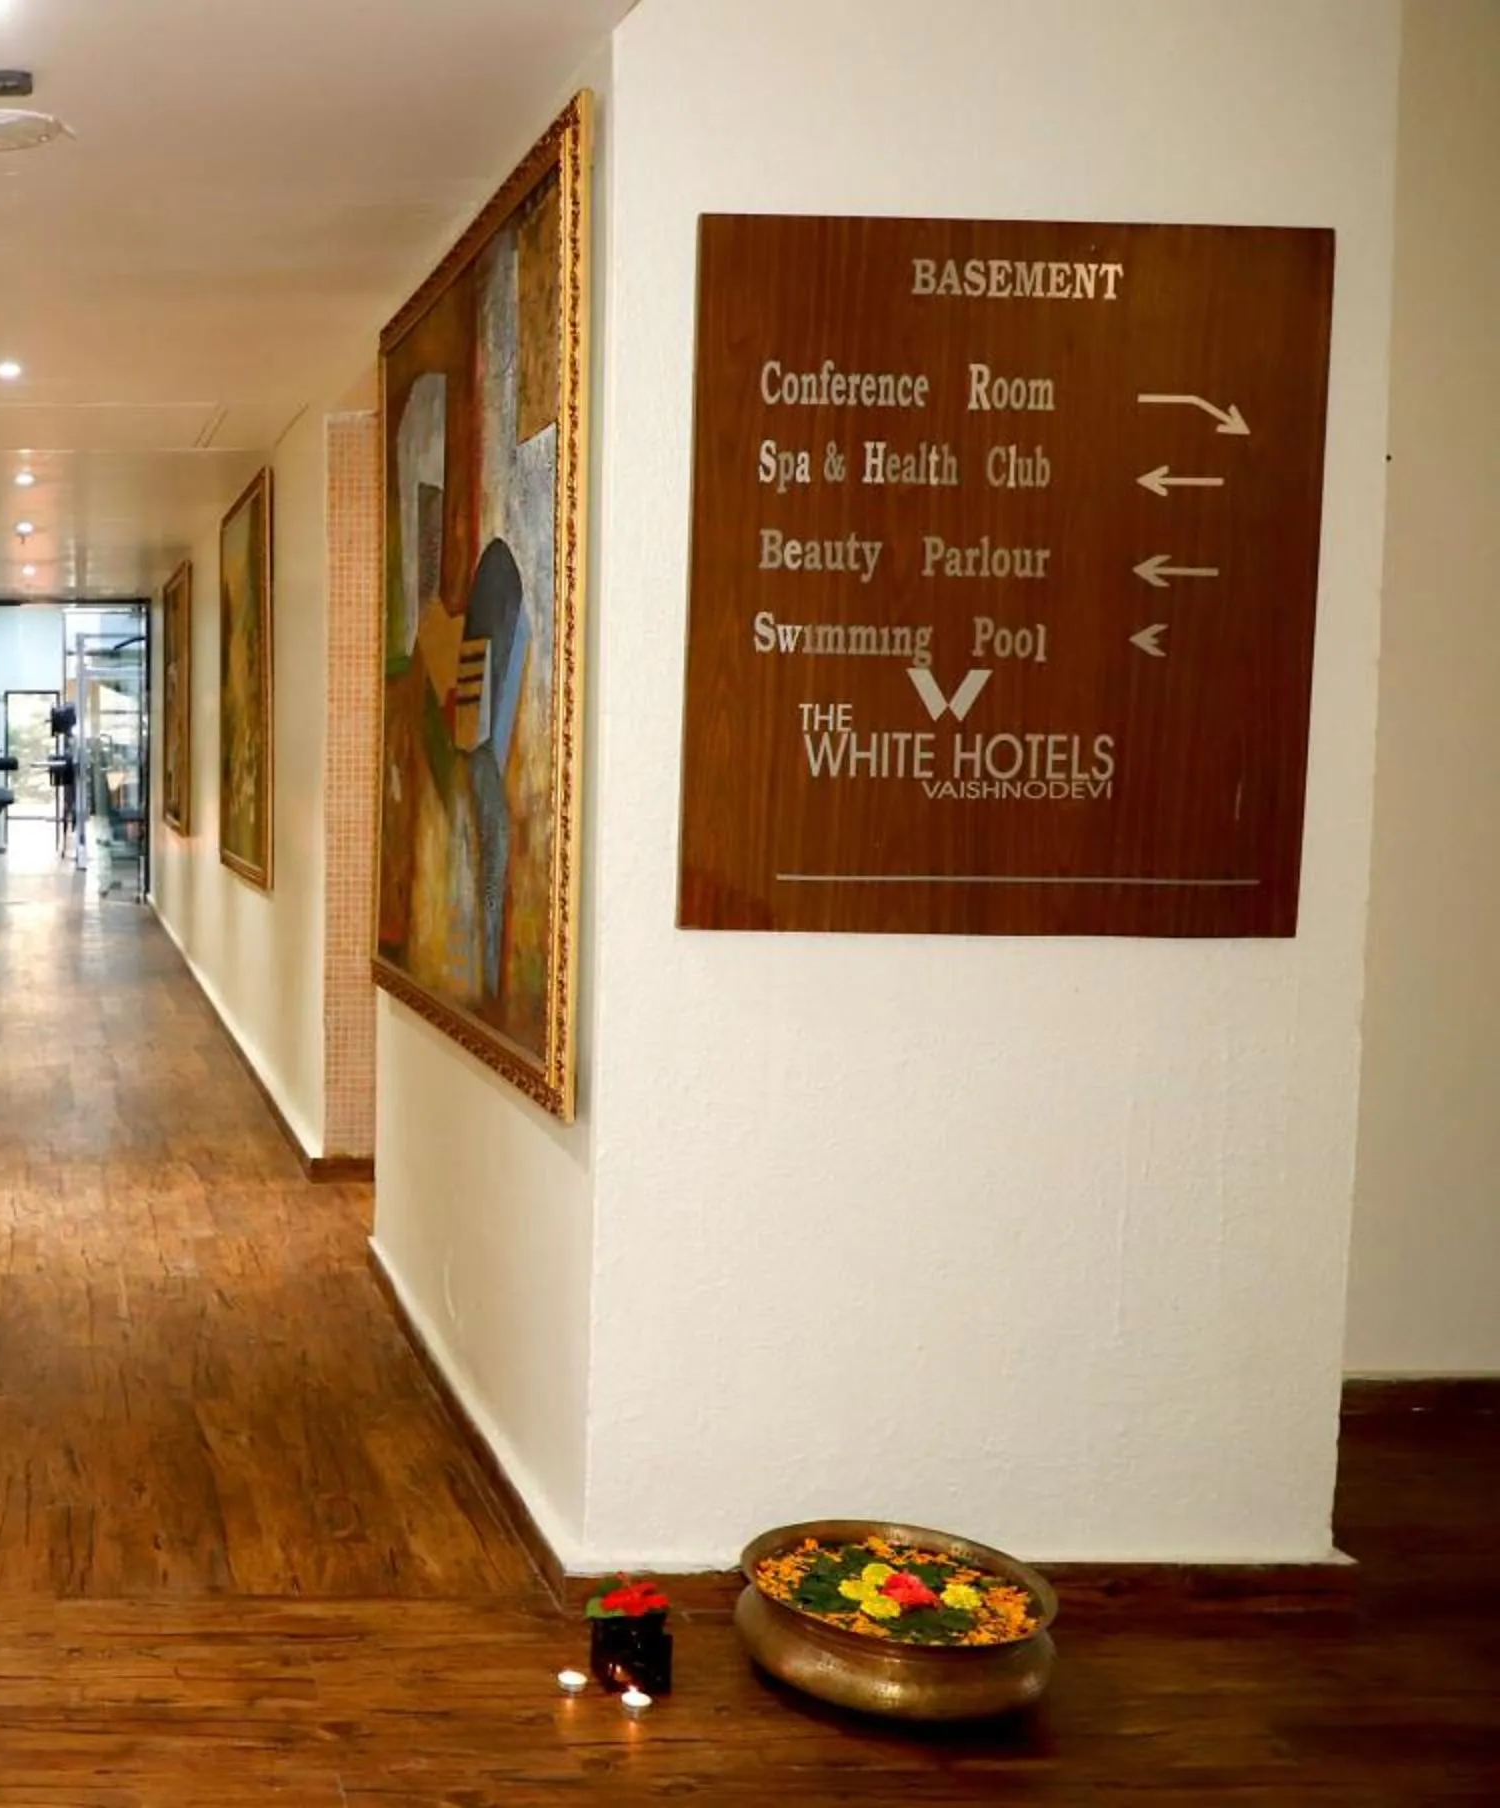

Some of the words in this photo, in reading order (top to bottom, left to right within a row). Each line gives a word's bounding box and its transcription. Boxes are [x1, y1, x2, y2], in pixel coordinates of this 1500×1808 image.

[912, 258, 1124, 300] BASEMENT
[761, 360, 929, 407] Conference
[968, 363, 1055, 411] Room
[759, 439, 811, 494] Spa
[824, 441, 846, 482] &
[862, 441, 959, 486] Health
[987, 446, 1051, 488] Club
[759, 528, 883, 583] Beauty
[922, 535, 1051, 578] Parlour
[754, 611, 933, 667] Swimming
[973, 616, 1047, 662] Pool
[799, 703, 853, 732] THE
[804, 732, 936, 778] WHITE
[954, 733, 1115, 780] HOTELS
[921, 780, 1113, 799] VAISHNODEVI
